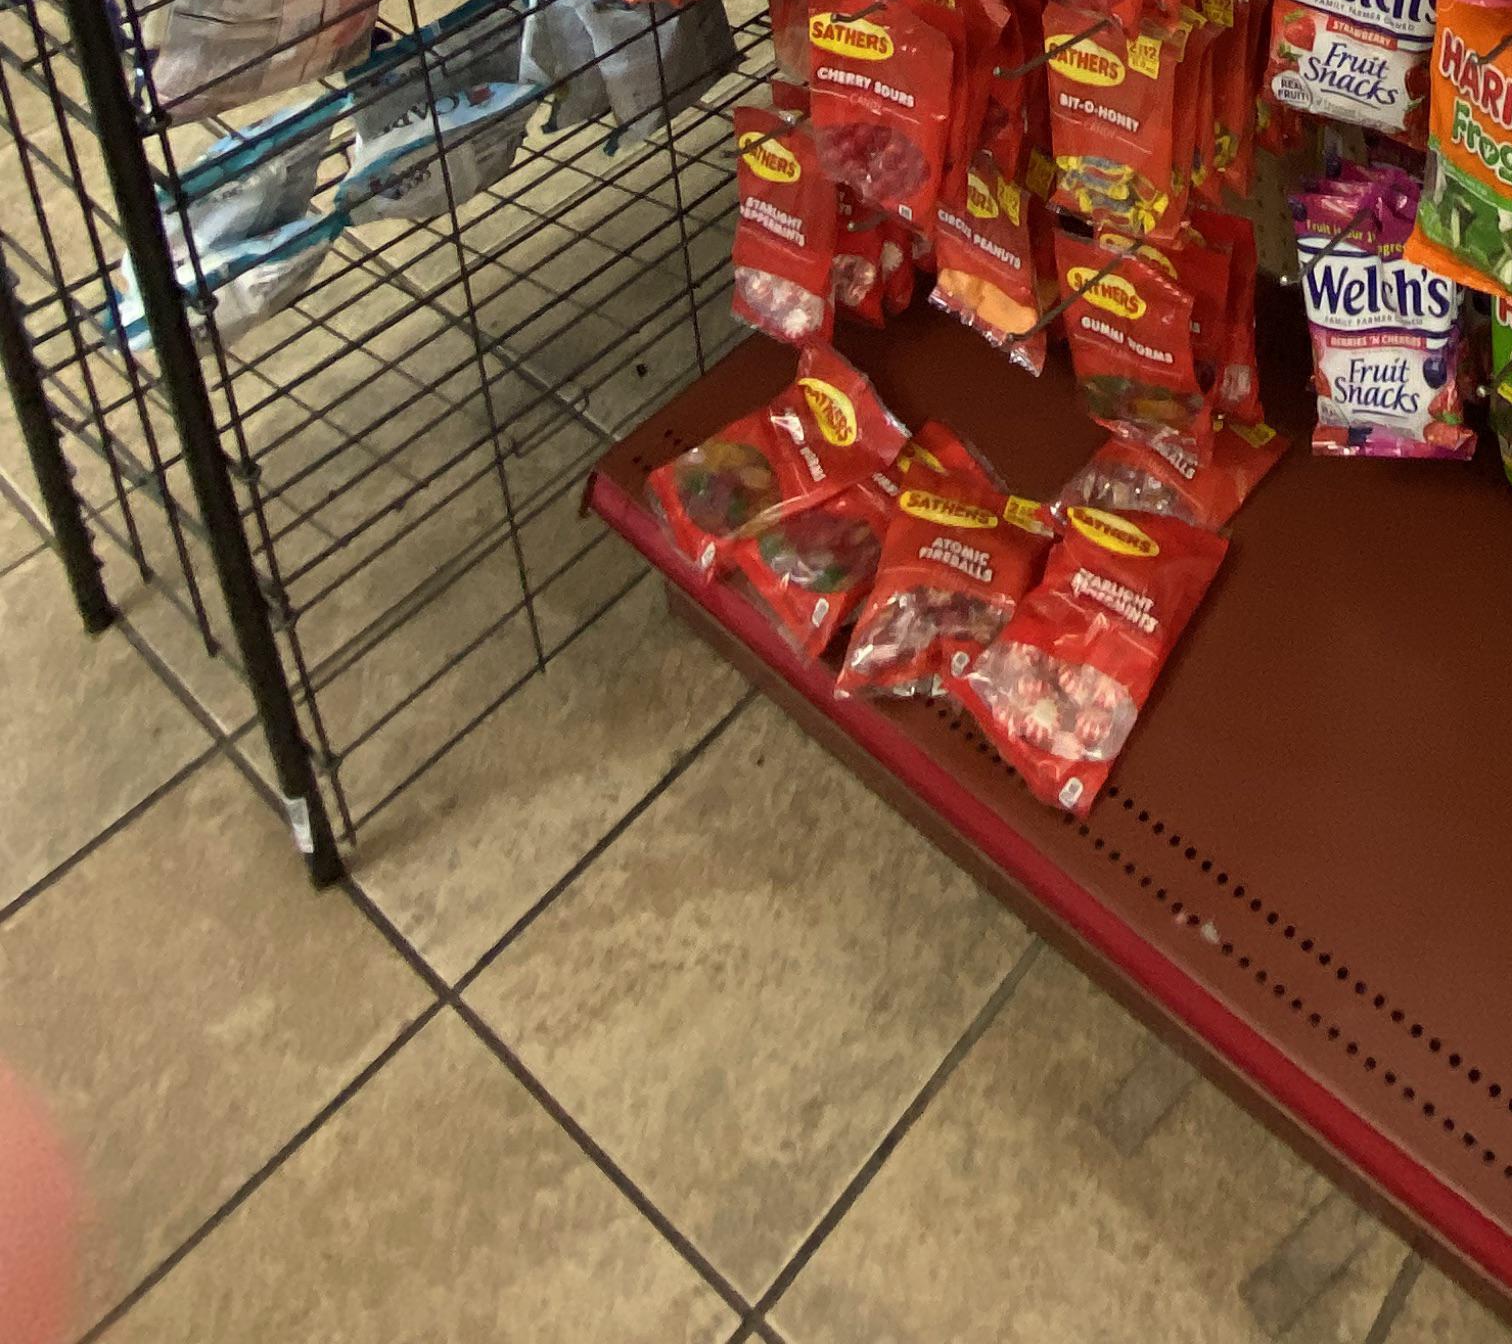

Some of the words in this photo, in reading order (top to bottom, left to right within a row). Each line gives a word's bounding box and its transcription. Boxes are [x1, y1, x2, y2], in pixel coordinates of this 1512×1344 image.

[811, 20, 890, 55] SATHERS
[1047, 41, 1121, 80] SATHERS
[1324, 41, 1390, 80] Fruit
[817, 66, 872, 94] CHERRY
[873, 80, 915, 109] SOURS
[1304, 58, 1400, 106] Snacks
[1059, 95, 1141, 133] BIT-O-HONEY
[1305, 262, 1451, 318] Welch's
[1348, 357, 1410, 385] Fruit
[1334, 377, 1420, 413] Snacks
